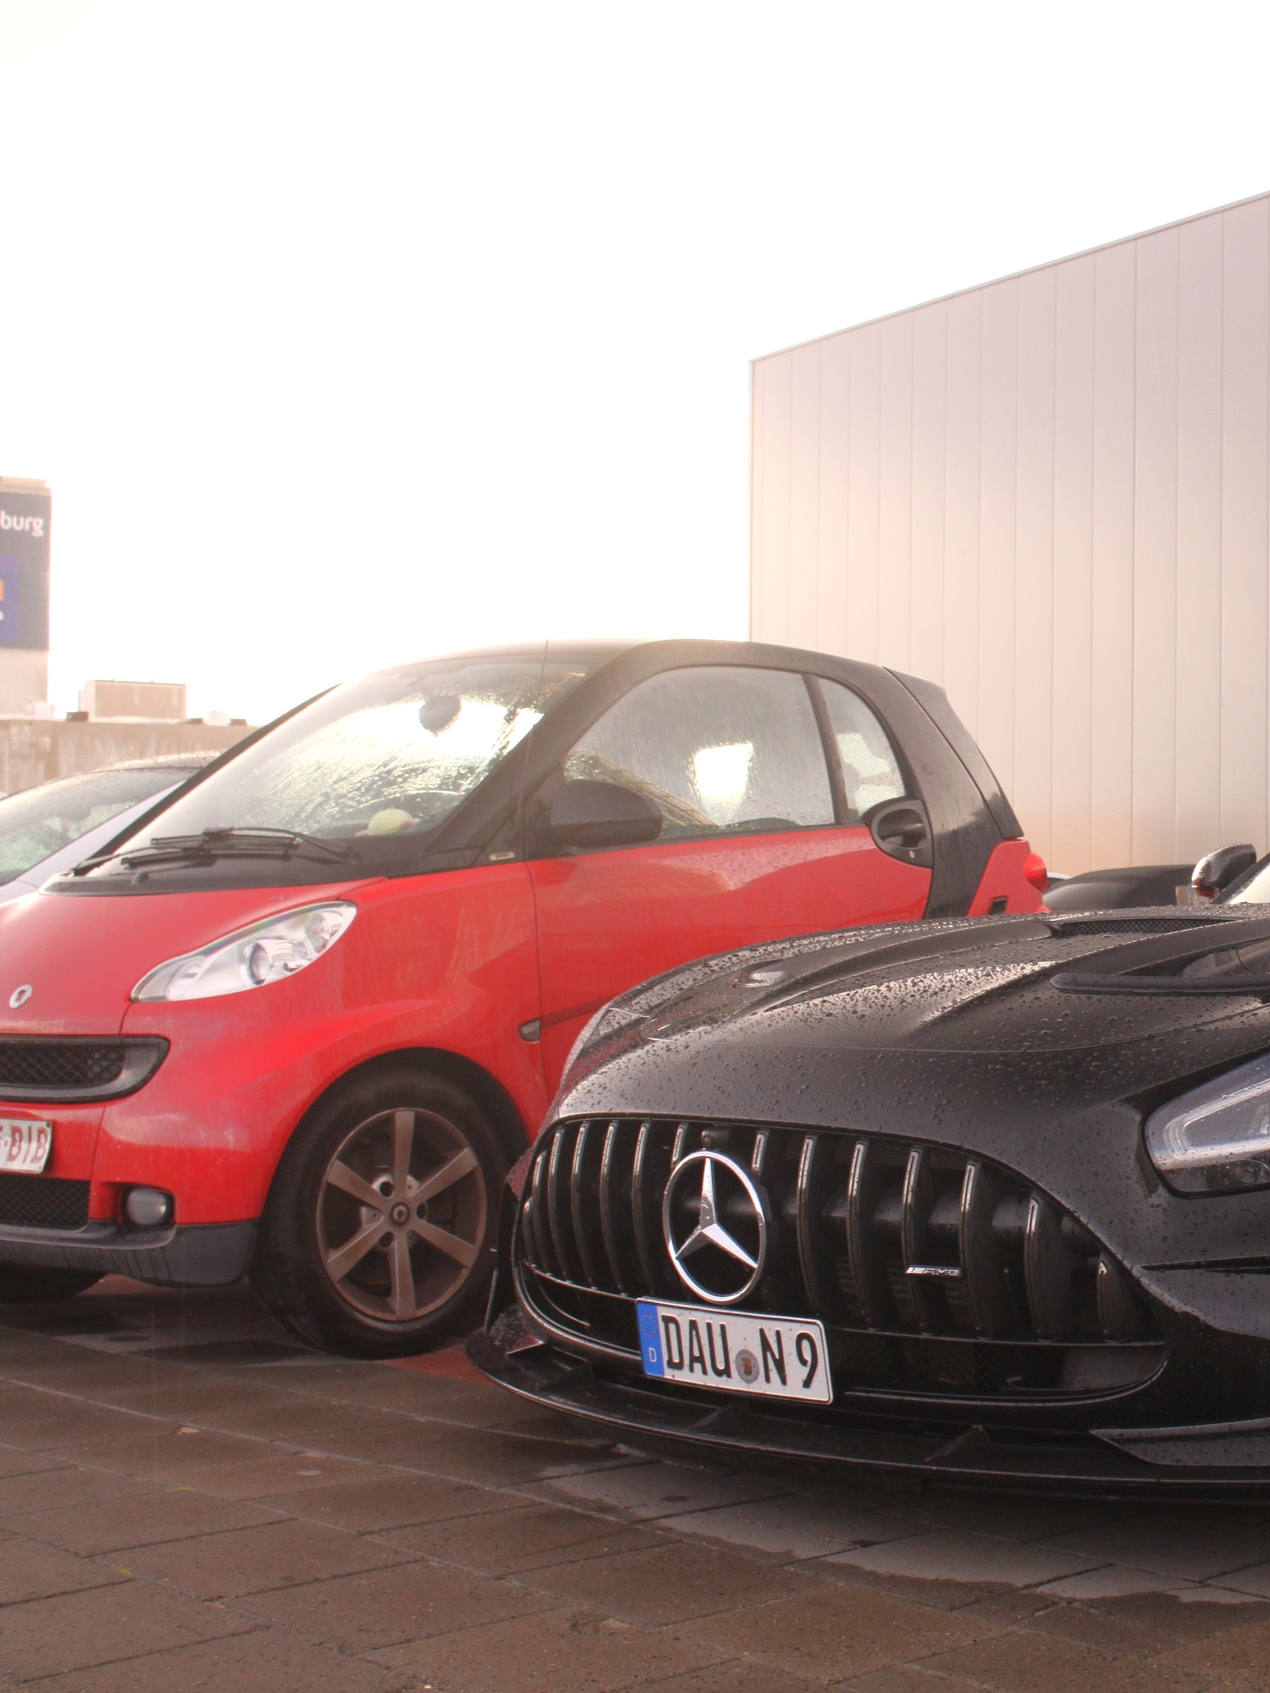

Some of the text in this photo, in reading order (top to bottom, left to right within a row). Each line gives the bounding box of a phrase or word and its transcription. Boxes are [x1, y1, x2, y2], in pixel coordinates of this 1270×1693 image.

[648, 1347, 657, 1363] D
[660, 1314, 818, 1388] DAU N 9
